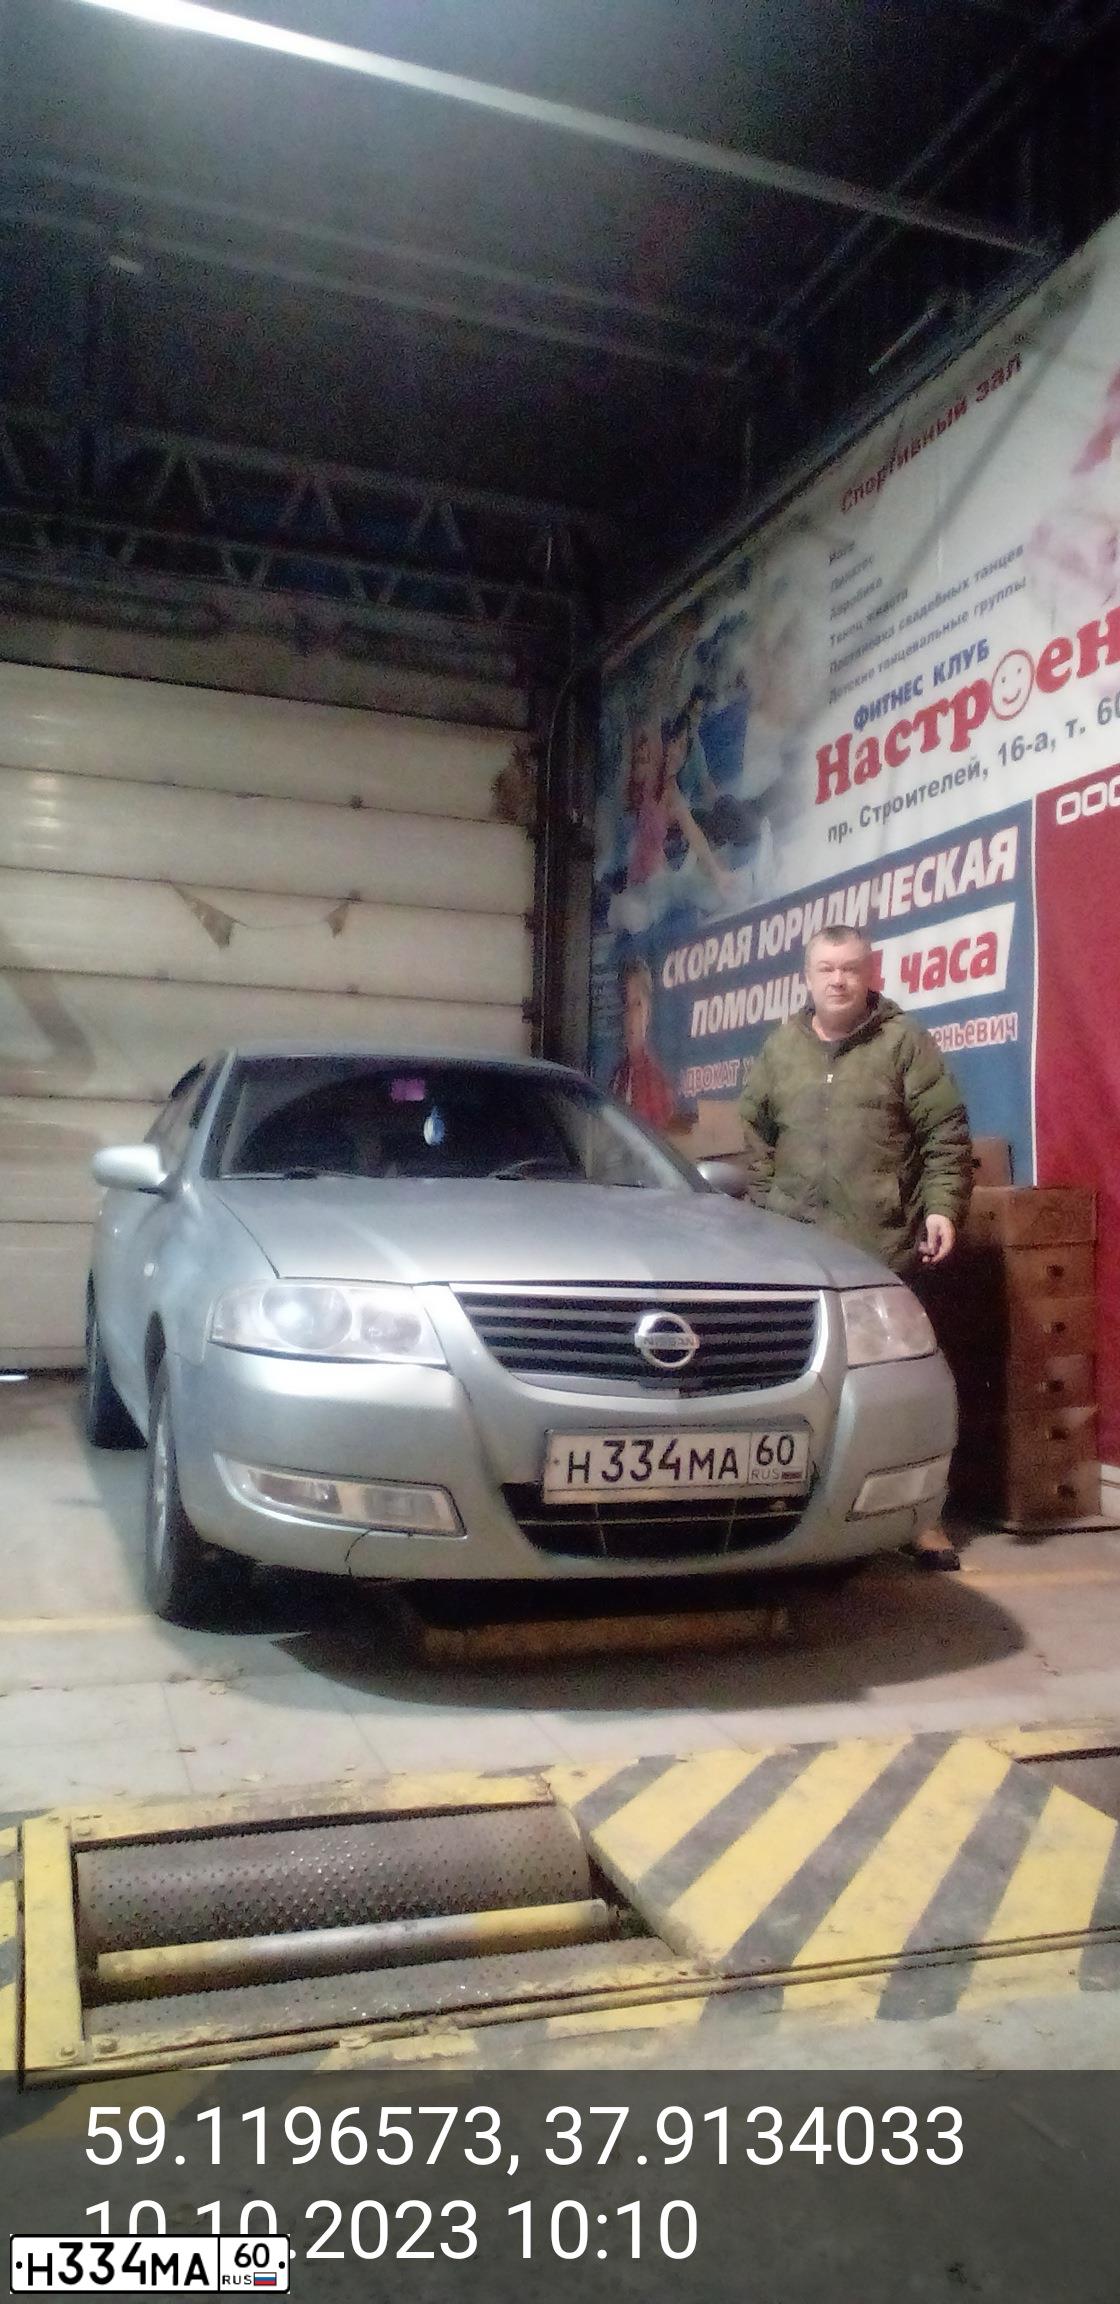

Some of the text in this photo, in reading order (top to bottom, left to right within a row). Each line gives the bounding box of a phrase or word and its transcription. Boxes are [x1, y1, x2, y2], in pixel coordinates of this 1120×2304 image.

[841, 353, 1023, 514] Спортивный зал
[879, 611, 969, 673] танцевальные
[973, 576, 1026, 620] группы
[899, 577, 970, 631] свадебных
[974, 545, 1024, 582] танцев
[853, 638, 990, 732] ФИТНЕС КЛУБ
[827, 818, 853, 844] пр.
[859, 756, 988, 828] Строителей,
[998, 731, 1056, 767] 16-а,
[662, 826, 1018, 989] СКОРАЯ ЮРИДИЧЕСКАЯ
[691, 973, 808, 1038] ПОМОЩЬ
[900, 931, 998, 994] часа
[567, 1434, 795, 1484] Н334МА 60
[751, 1469, 779, 1480] RUS
